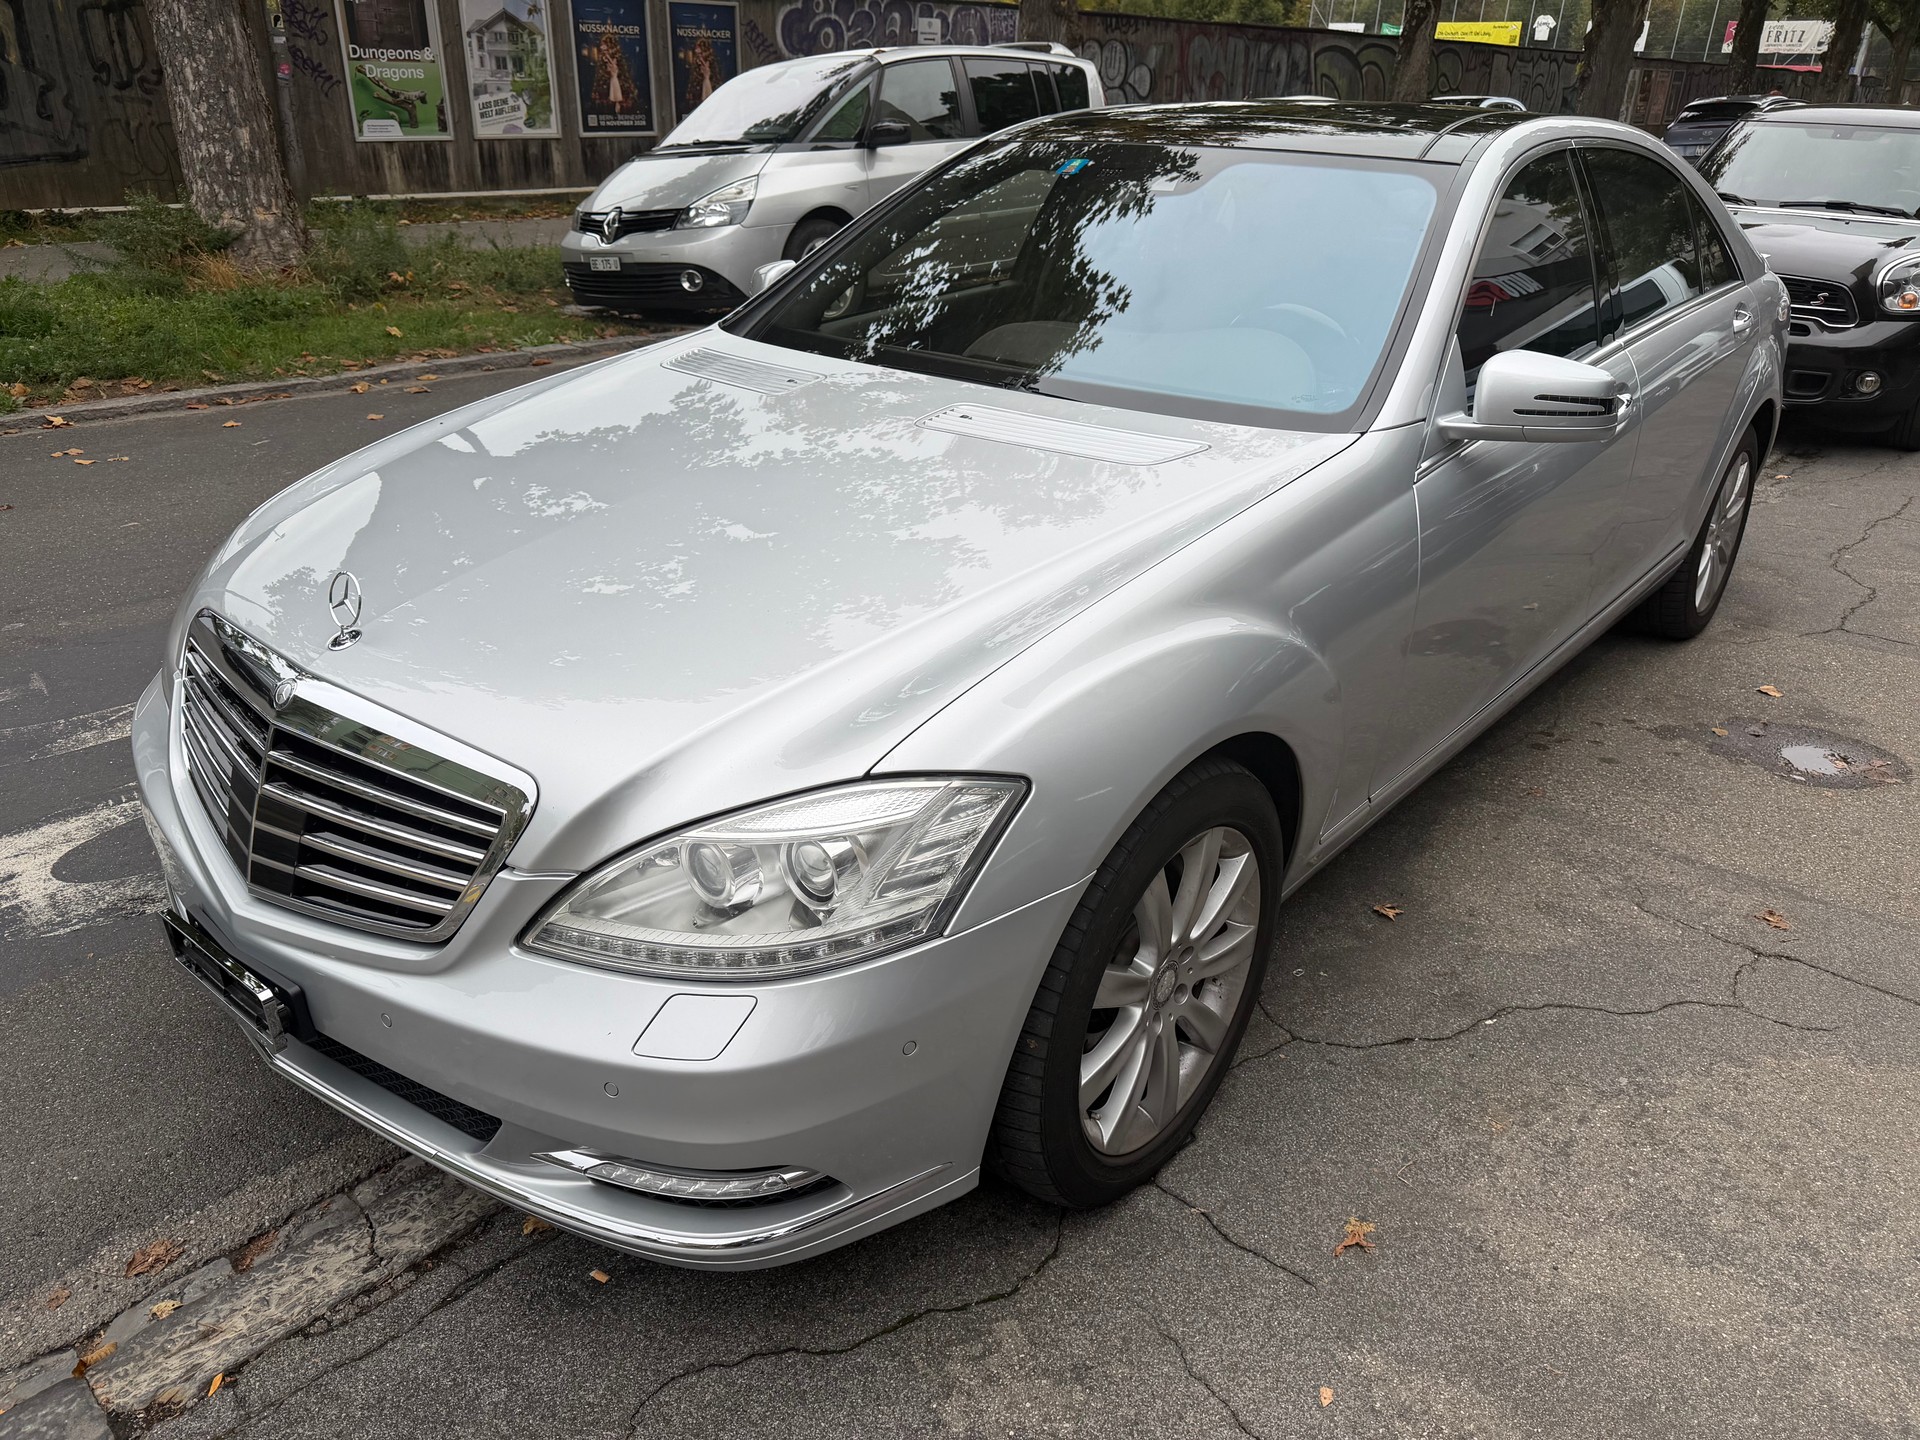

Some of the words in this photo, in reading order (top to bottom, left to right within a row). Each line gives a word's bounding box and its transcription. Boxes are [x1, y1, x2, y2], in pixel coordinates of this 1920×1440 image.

[1766, 30, 1806, 43] FRITZ
[348, 44, 421, 62] Dungeons
[423, 47, 435, 60] &
[365, 64, 424, 81] Dragons
[478, 101, 492, 110] LASS
[493, 97, 509, 107] DEINE
[479, 109, 494, 119] WELT
[495, 104, 521, 116] AUFLEBEN
